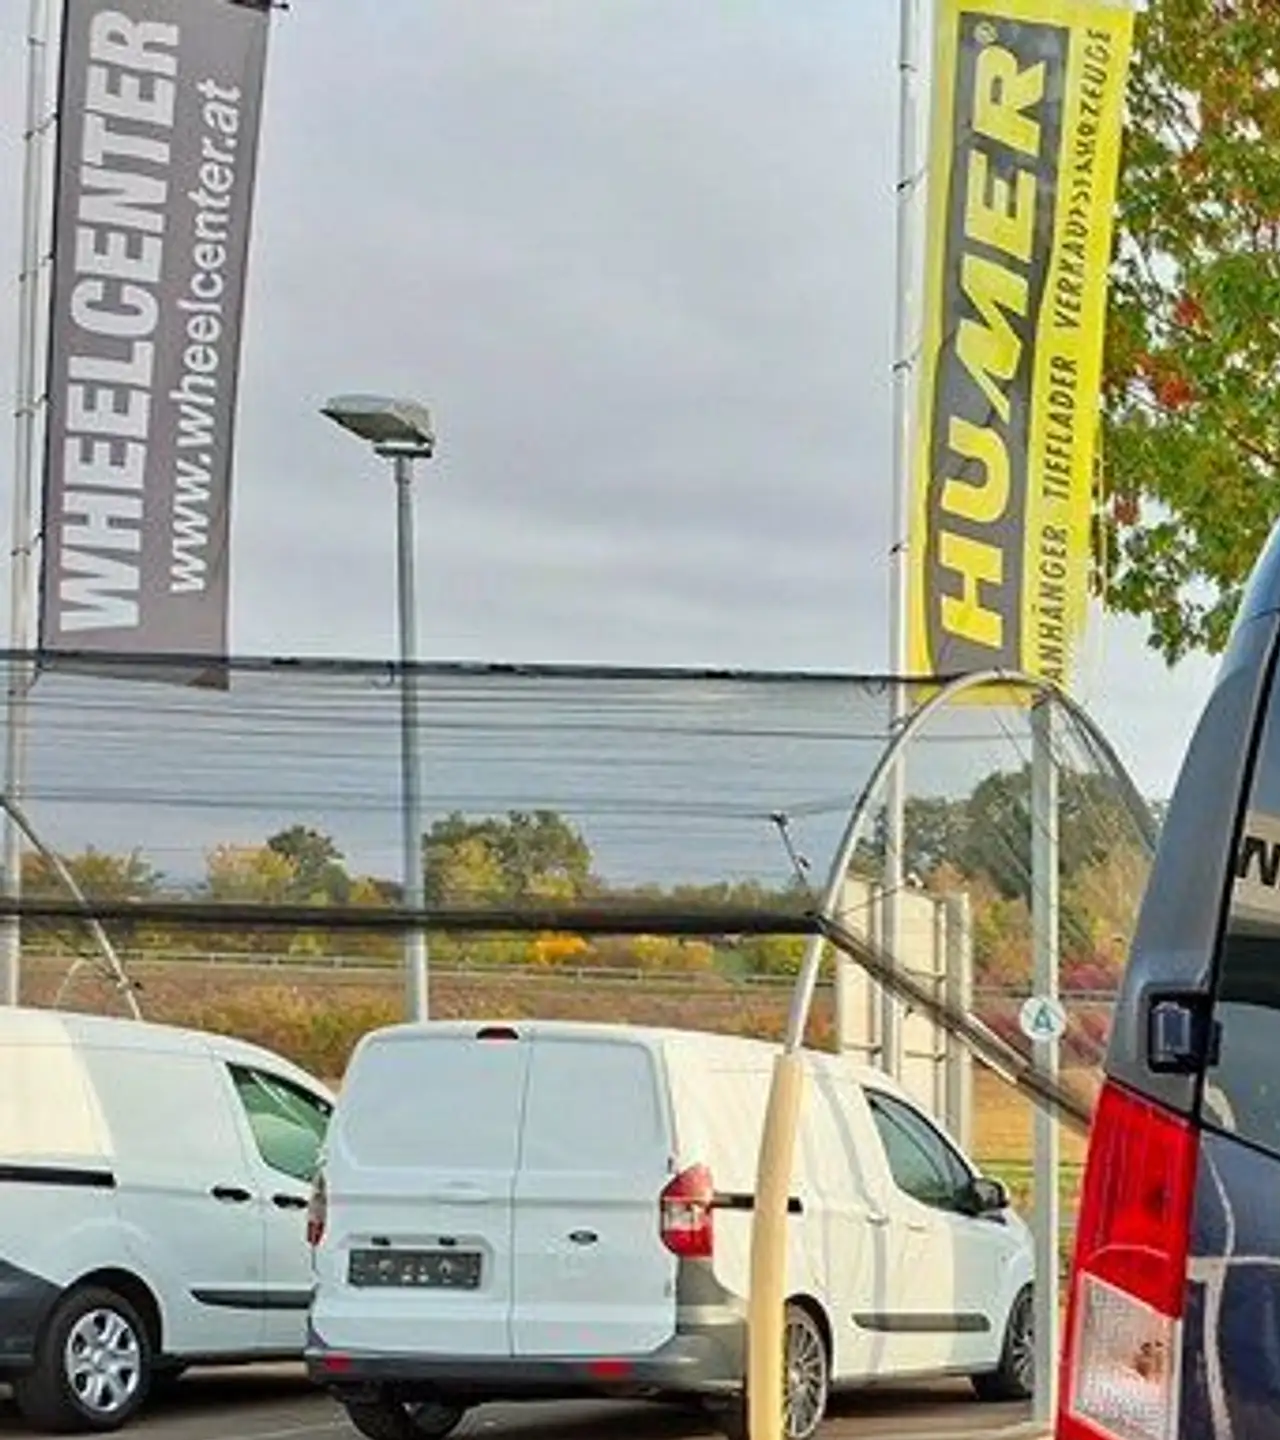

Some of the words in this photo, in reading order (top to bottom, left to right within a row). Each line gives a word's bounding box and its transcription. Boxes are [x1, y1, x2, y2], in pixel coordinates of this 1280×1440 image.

[59, 9, 180, 632] WHEELCENTER
[169, 77, 242, 594] www.wheelcenter.at
[1042, 355, 1078, 502] TIEFLADER
[1032, 524, 1069, 686] ANHÄNGER
